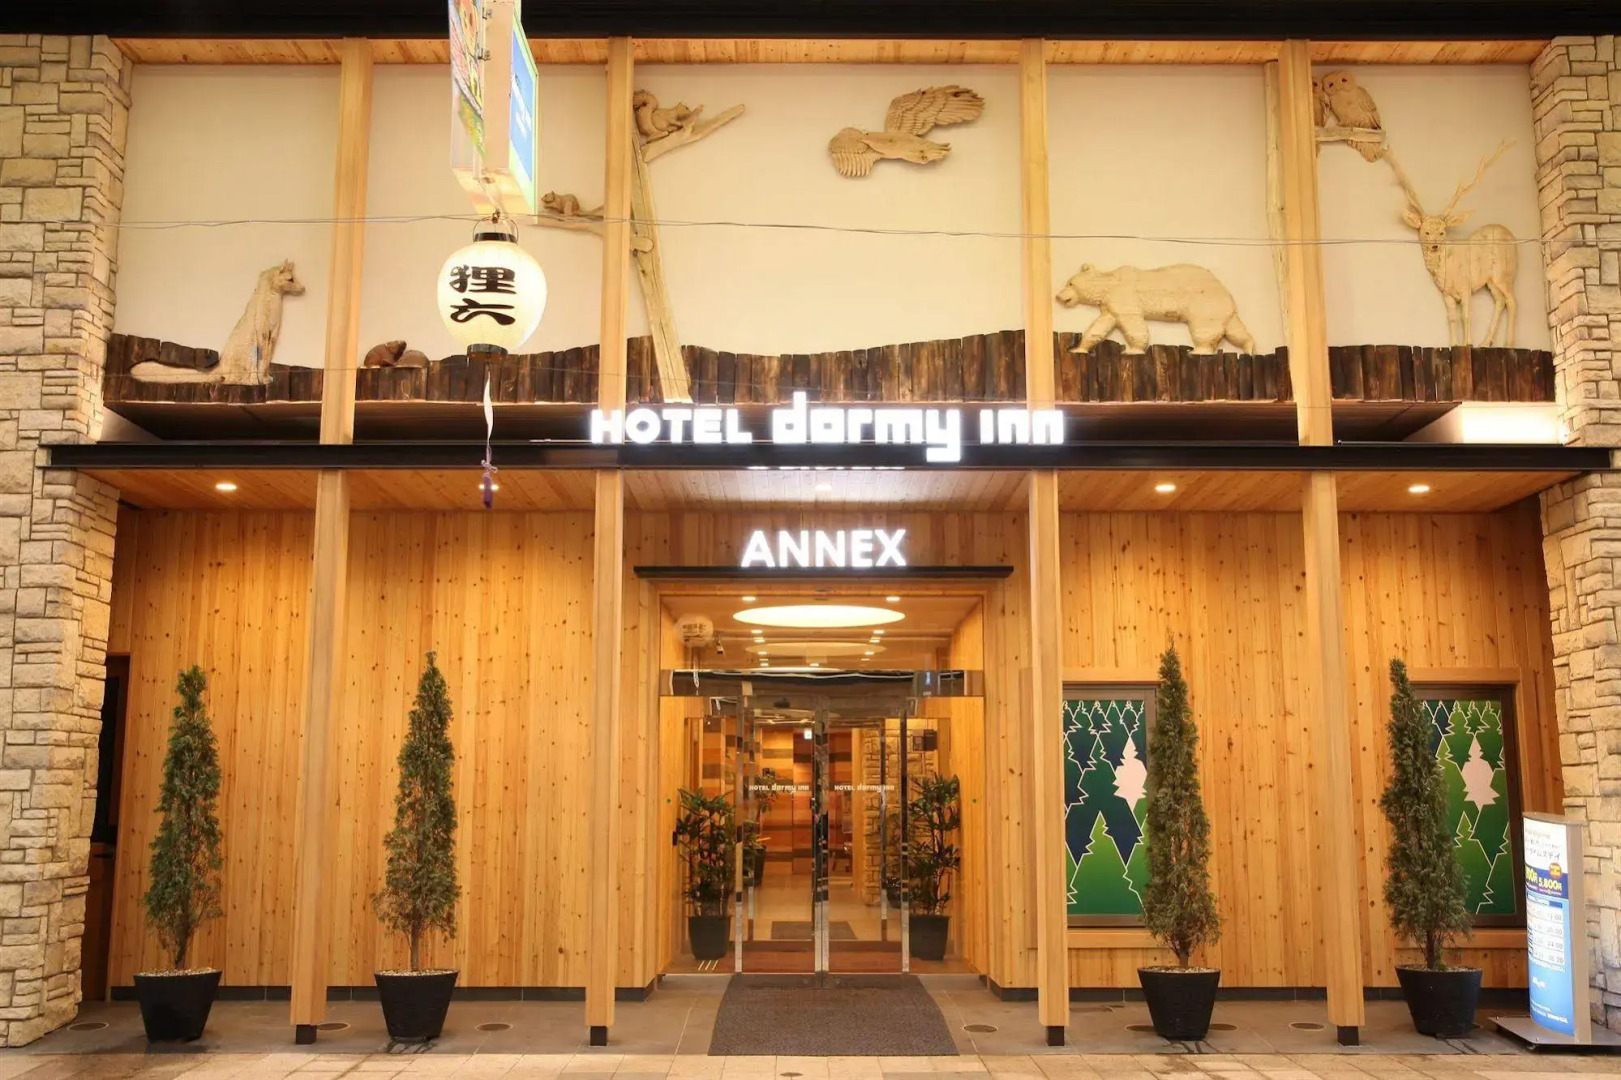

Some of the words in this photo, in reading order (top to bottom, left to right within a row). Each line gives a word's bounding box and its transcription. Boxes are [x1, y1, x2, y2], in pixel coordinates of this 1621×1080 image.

[591, 408, 752, 444] HOTEL
[772, 391, 961, 462] dormy
[980, 409, 1064, 444] inn
[741, 529, 907, 568] ANNEX
[771, 783, 796, 794] dormy
[857, 783, 882, 793] dormy
